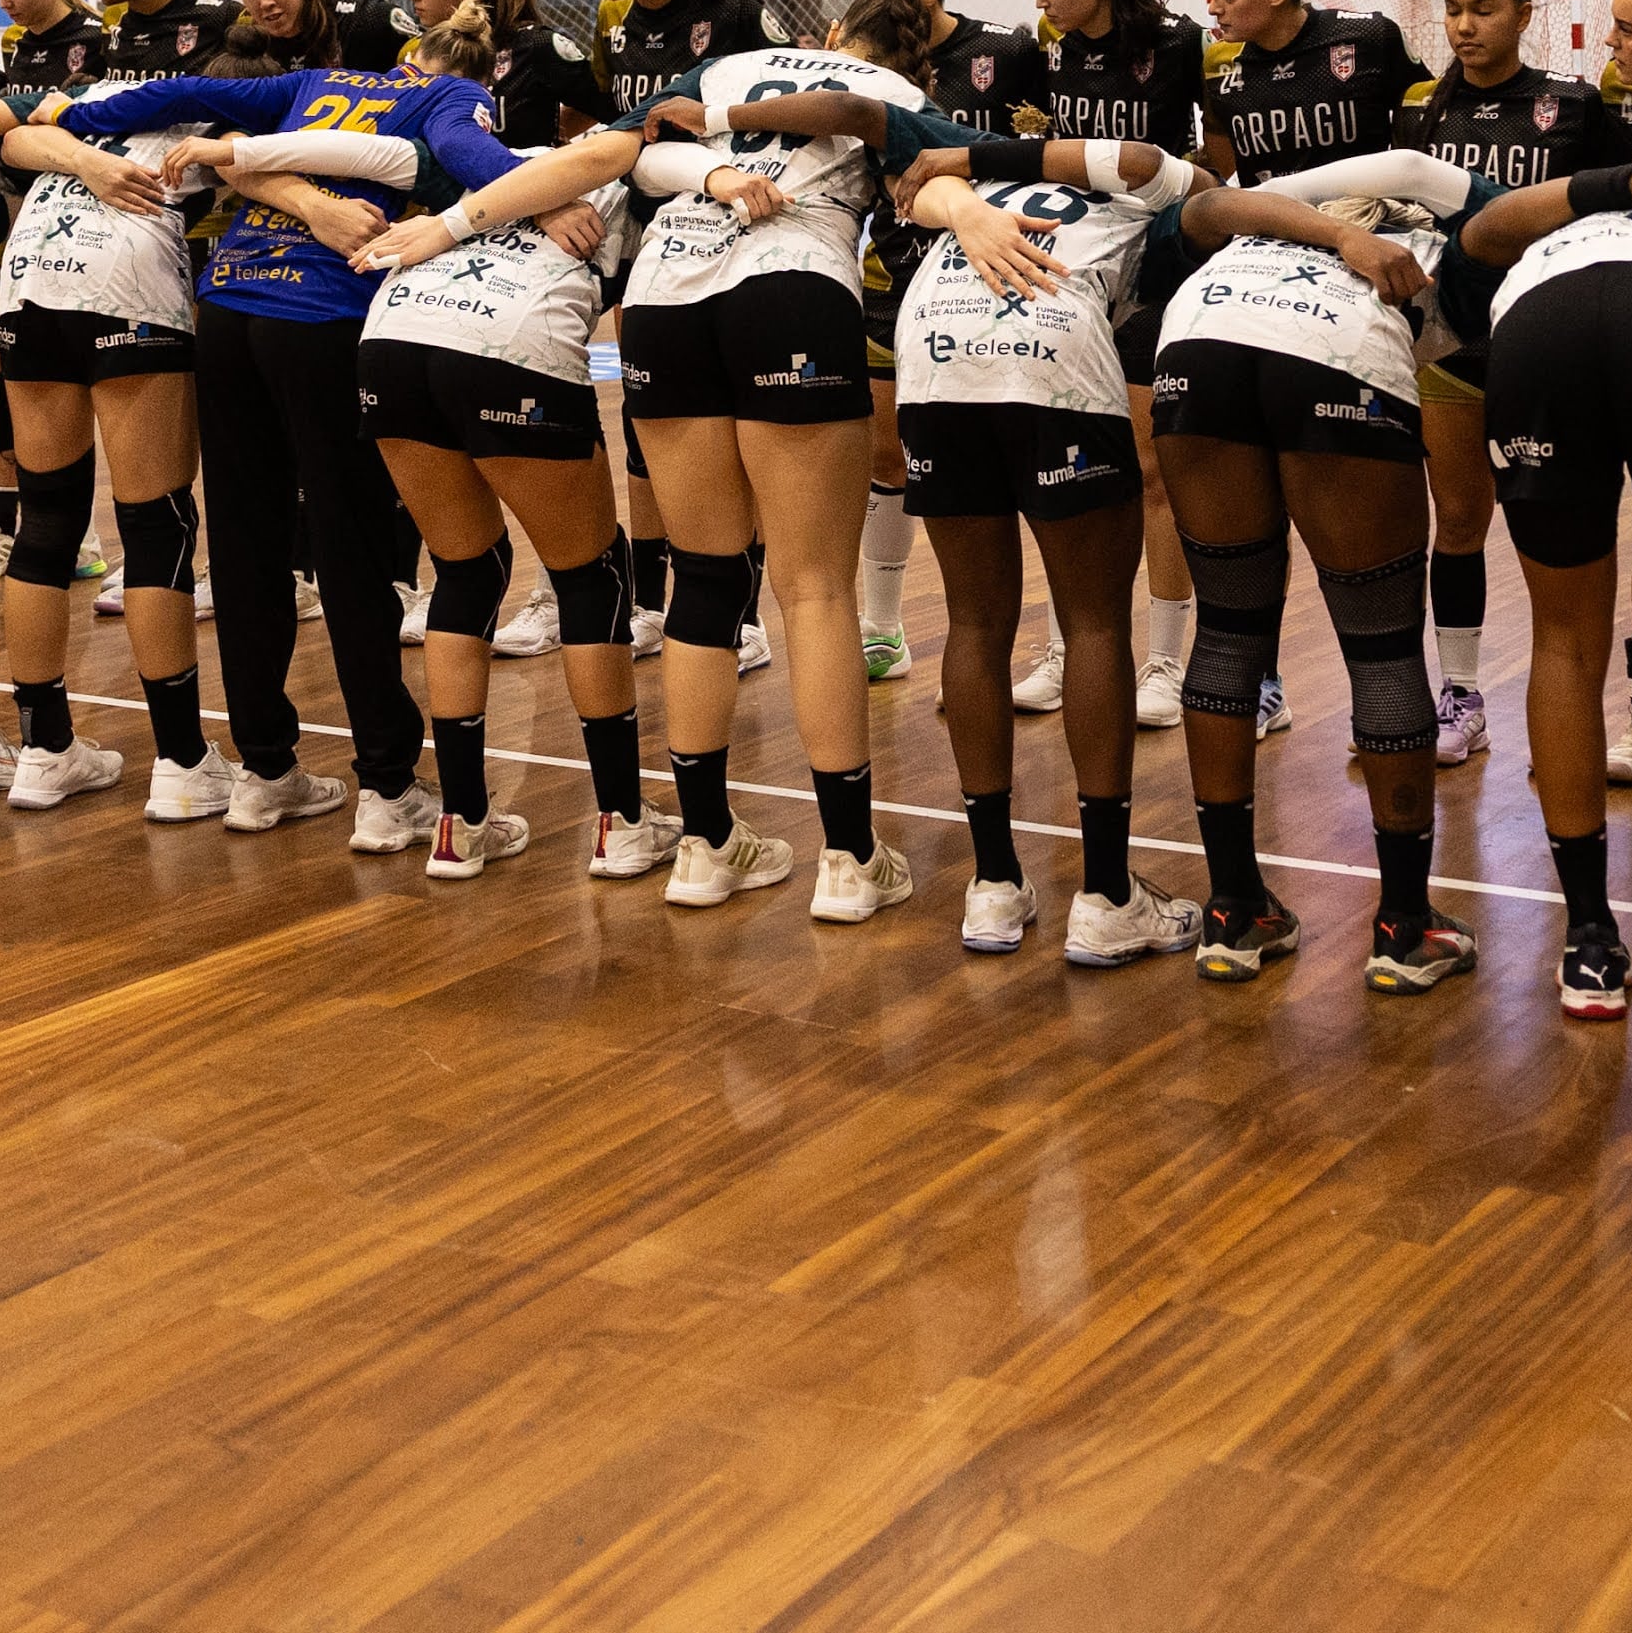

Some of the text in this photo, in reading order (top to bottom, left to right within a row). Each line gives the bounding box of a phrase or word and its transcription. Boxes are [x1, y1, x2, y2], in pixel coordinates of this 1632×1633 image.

[298, 94, 398, 134] 25
[1231, 99, 1359, 158] ORPAGU
[235, 265, 305, 284] teleelx
[936, 274, 969, 286] OASIS
[415, 290, 499, 320] teleelx
[929, 306, 992, 318] DE ALICANTE
[930, 296, 992, 309] DIPUTACIÓN
[1241, 290, 1340, 326] teleelx
[95, 330, 137, 350] suma
[965, 338, 1059, 364] teleelx
[753, 371, 801, 387] suma
[479, 407, 527, 426] suma
[1315, 401, 1368, 422] suma
[1037, 464, 1077, 486] suma
